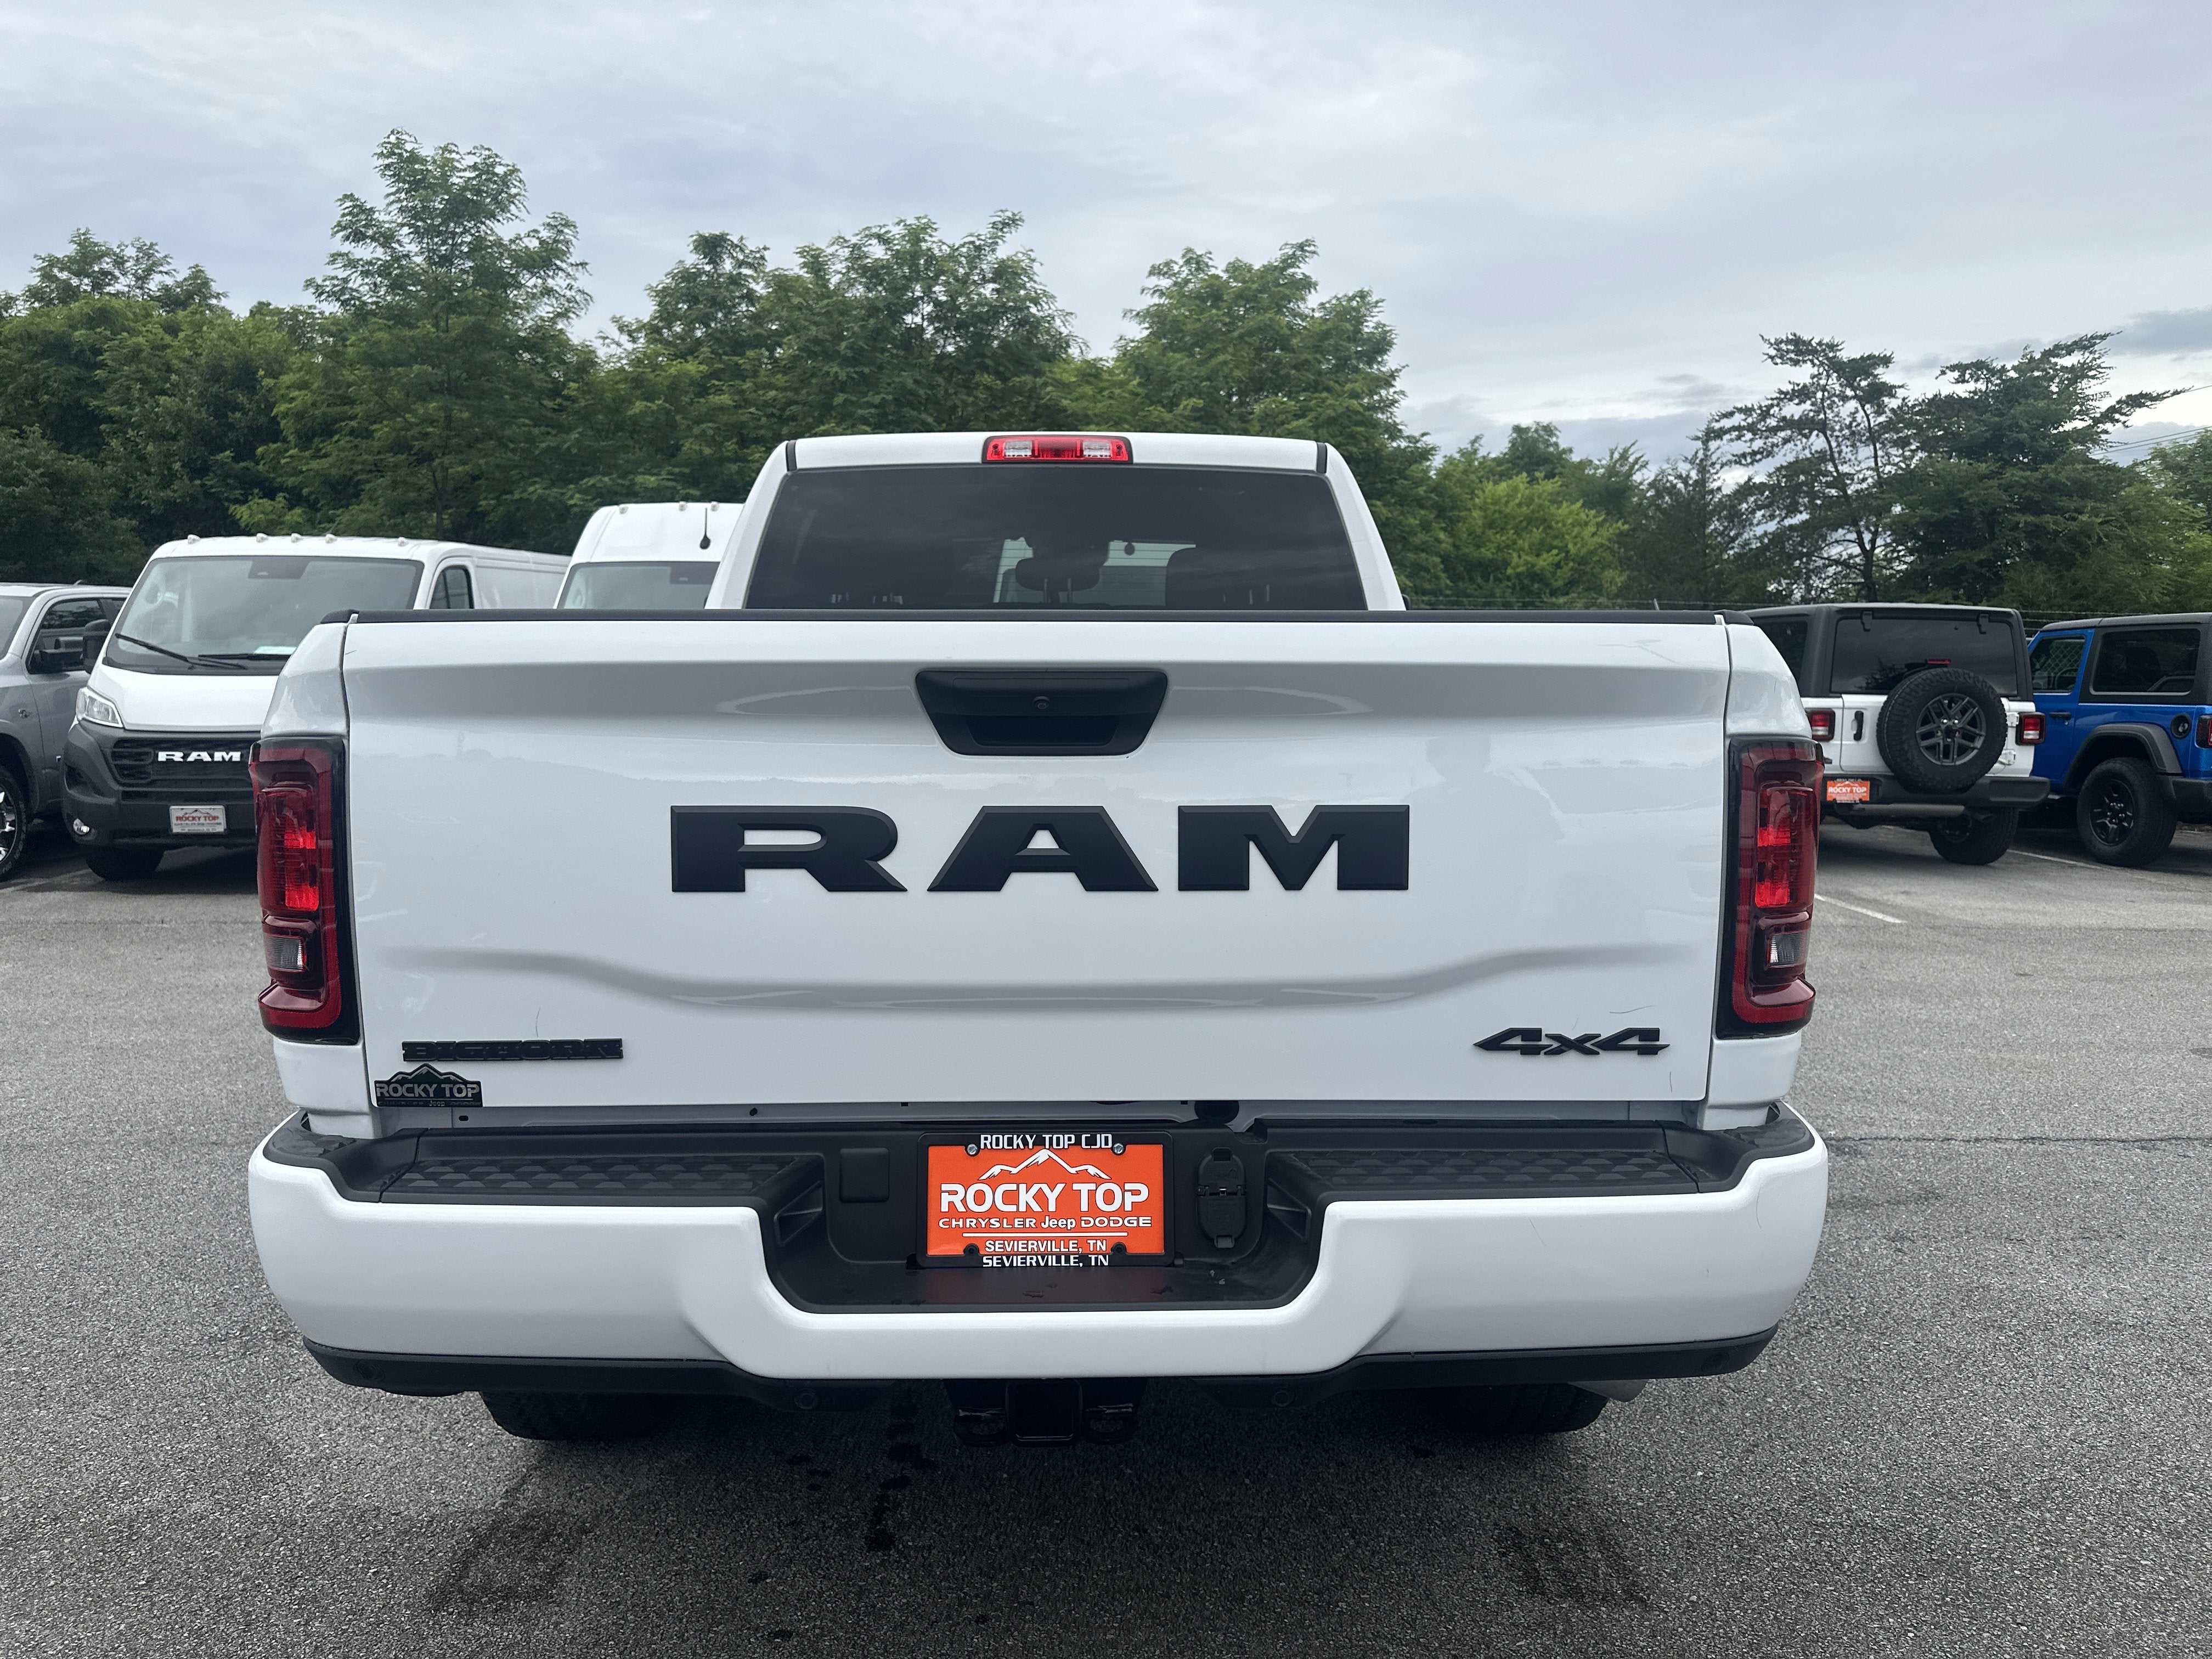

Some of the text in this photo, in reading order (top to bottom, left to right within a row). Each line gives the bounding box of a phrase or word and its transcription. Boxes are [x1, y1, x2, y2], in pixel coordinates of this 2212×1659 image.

[157, 751, 241, 762] RAM
[670, 805, 1409, 893] RAM
[376, 1084, 480, 1097] ROCKY TOP
[980, 1133, 1113, 1150] ROCKY TOP CJD
[940, 1182, 1150, 1213] ROCKY TOP
[938, 1216, 1152, 1230] CHRYSLER Jeep DODGE
[985, 1239, 1107, 1254] SEVIERVILLE, TN
[982, 1255, 1109, 1268] SEVIERVILLE, TN
